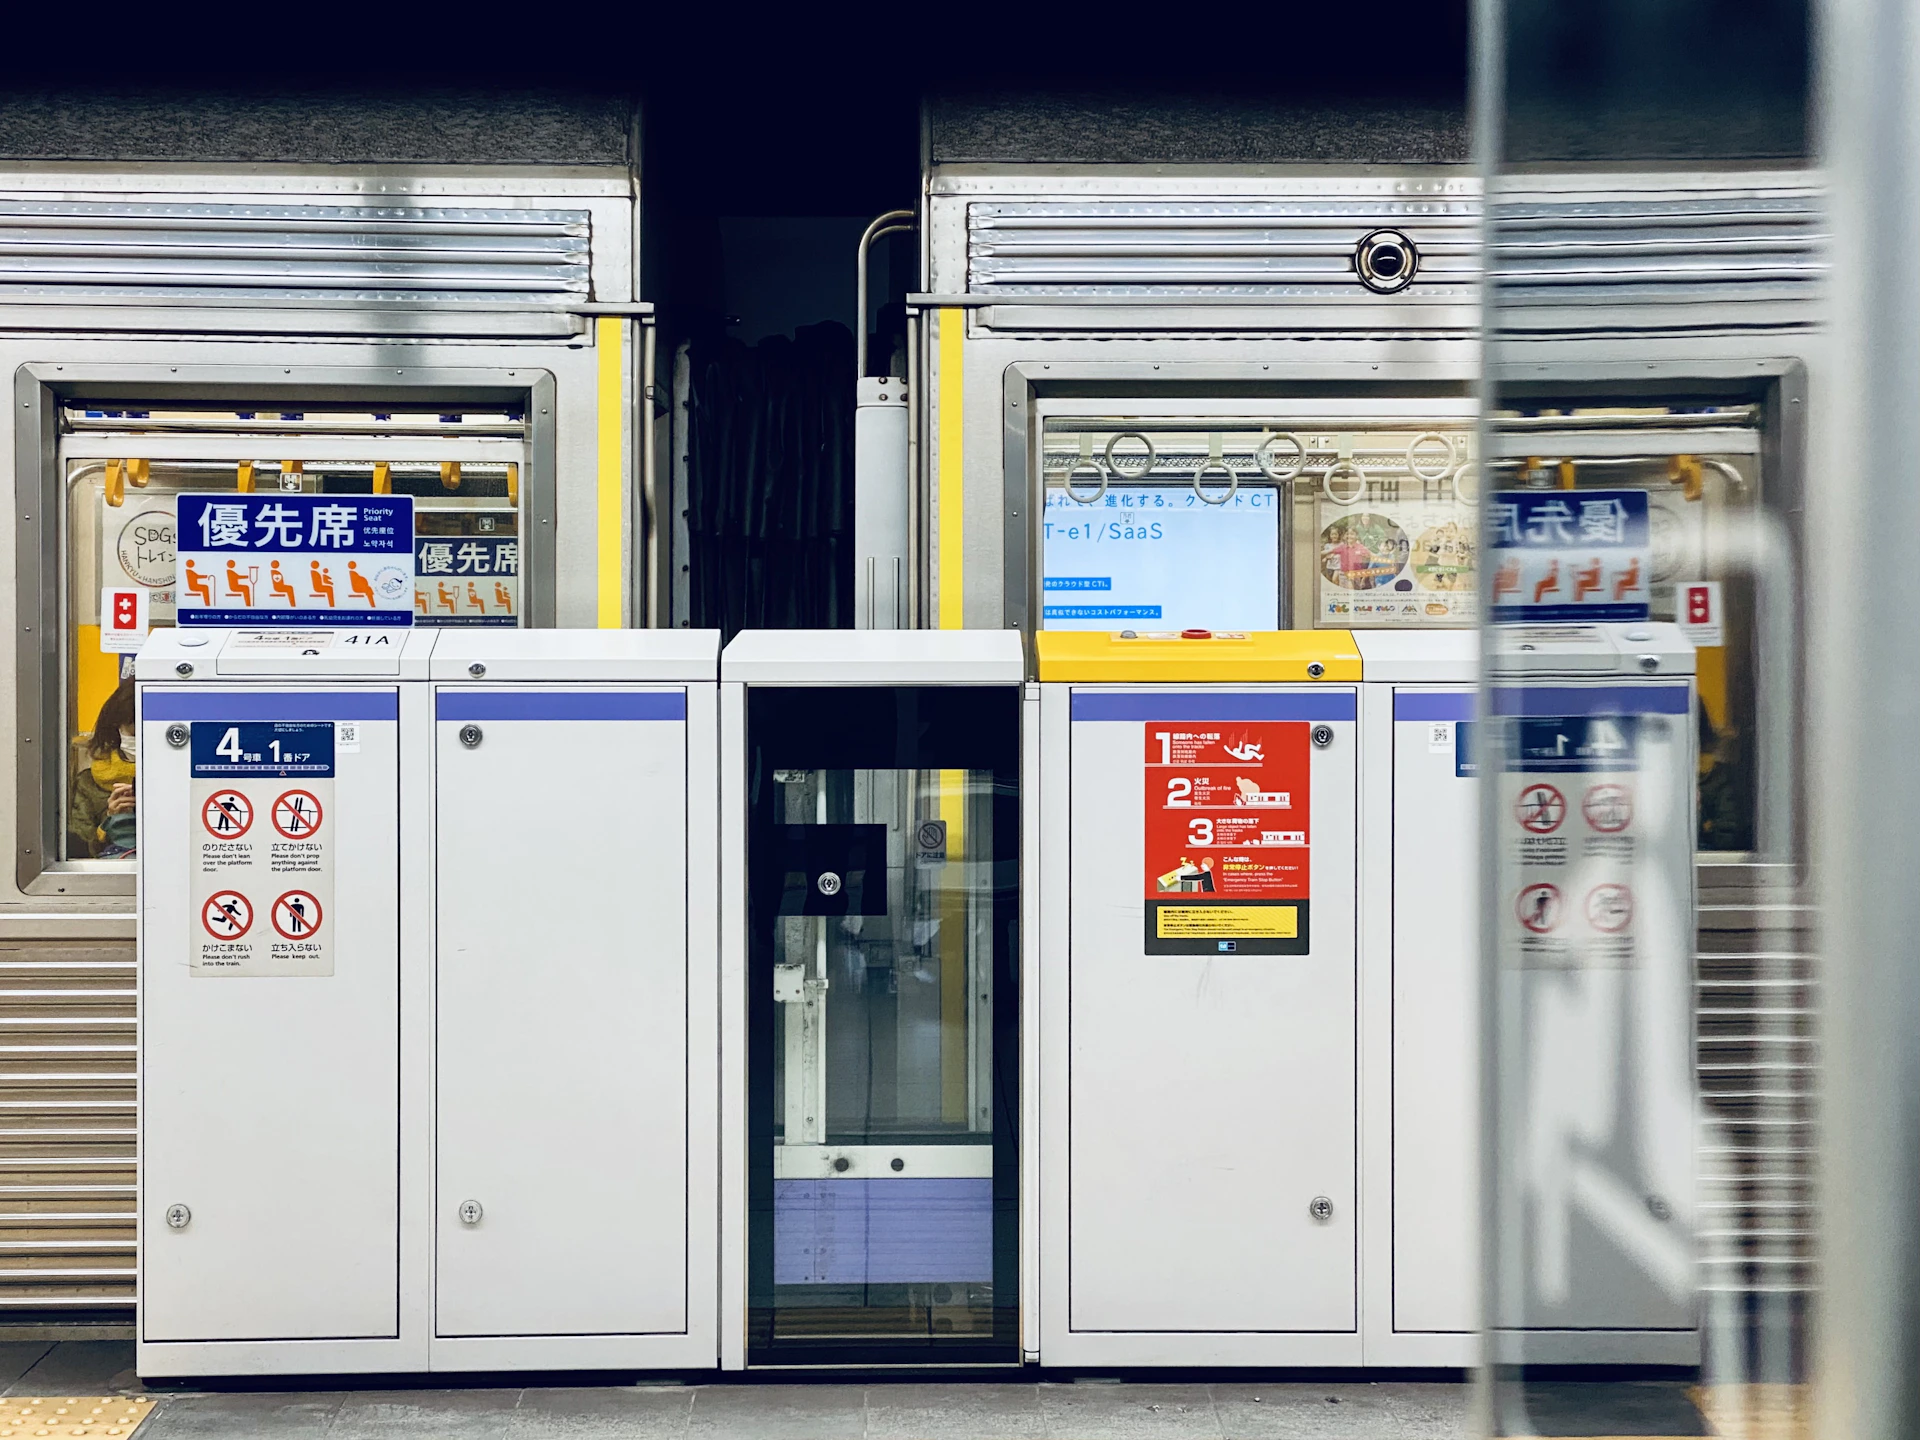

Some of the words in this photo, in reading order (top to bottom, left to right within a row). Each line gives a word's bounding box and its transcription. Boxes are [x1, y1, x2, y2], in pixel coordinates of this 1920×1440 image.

[363, 508, 394, 516] Priority
[198, 503, 357, 548] 優先席
[363, 540, 393, 548] 노약자석
[121, 550, 139, 577] HANKYU
[142, 574, 176, 584] HANSHIN
[137, 546, 176, 568] トレイン
[418, 542, 517, 573] 優先席
[344, 635, 389, 645] 41A
[216, 727, 262, 763] 4号車
[269, 740, 311, 763] 1番ドア
[1155, 732, 1170, 764] 1
[1167, 777, 1191, 806] 2
[1188, 818, 1214, 845] 3
[203, 843, 252, 852] のりださない
[271, 843, 322, 852] 立てかけない
[203, 944, 252, 953] かけこまない
[271, 944, 322, 952] 立ち入らない
